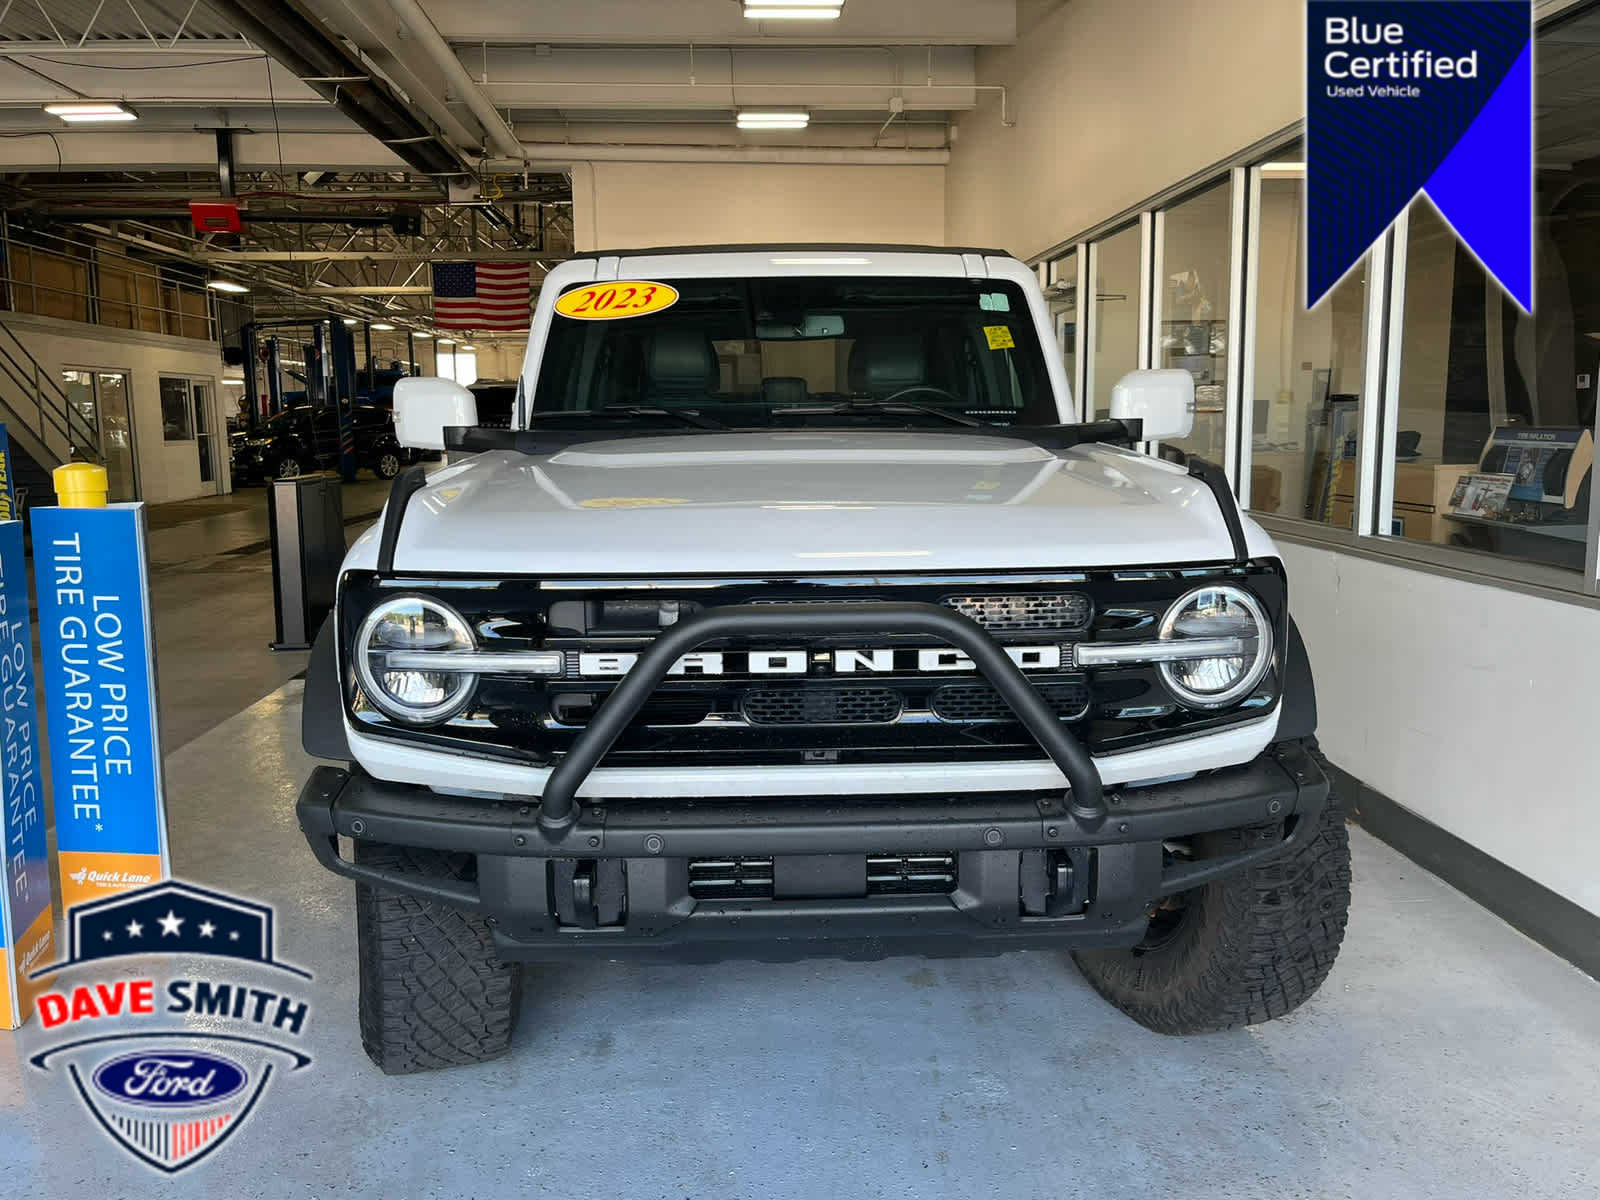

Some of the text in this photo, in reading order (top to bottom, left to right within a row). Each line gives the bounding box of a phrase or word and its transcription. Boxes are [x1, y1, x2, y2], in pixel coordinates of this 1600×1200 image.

[572, 286, 657, 313] 2023
[53, 531, 84, 605] TIRE
[92, 595, 132, 776] LOW PRICE
[579, 645, 1061, 675] BRONCO
[11, 621, 37, 832] LOW PRICE
[88, 870, 151, 883] Quick Lane
